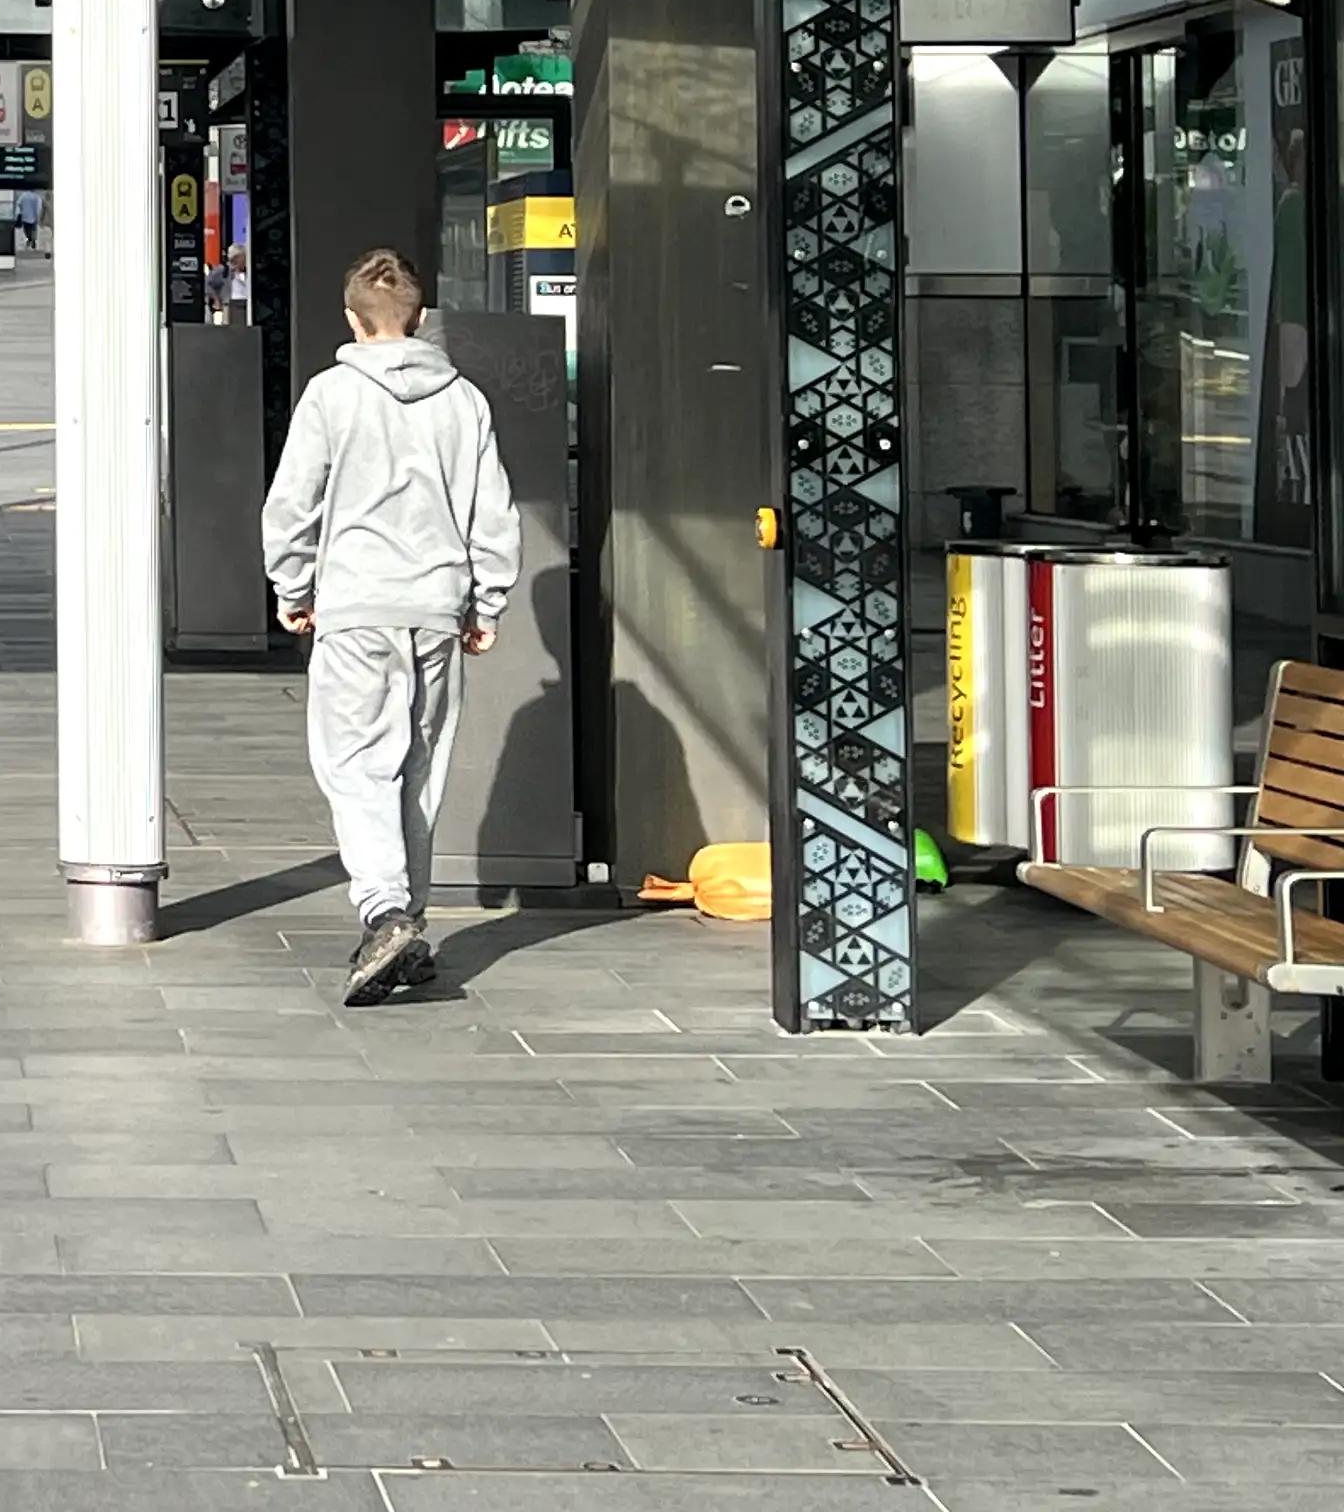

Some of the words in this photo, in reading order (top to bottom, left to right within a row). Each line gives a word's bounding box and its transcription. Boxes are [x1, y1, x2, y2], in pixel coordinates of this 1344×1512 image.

[32, 97, 44, 112] A
[949, 596, 968, 770] Recycling
[1029, 613, 1046, 709] Litter
